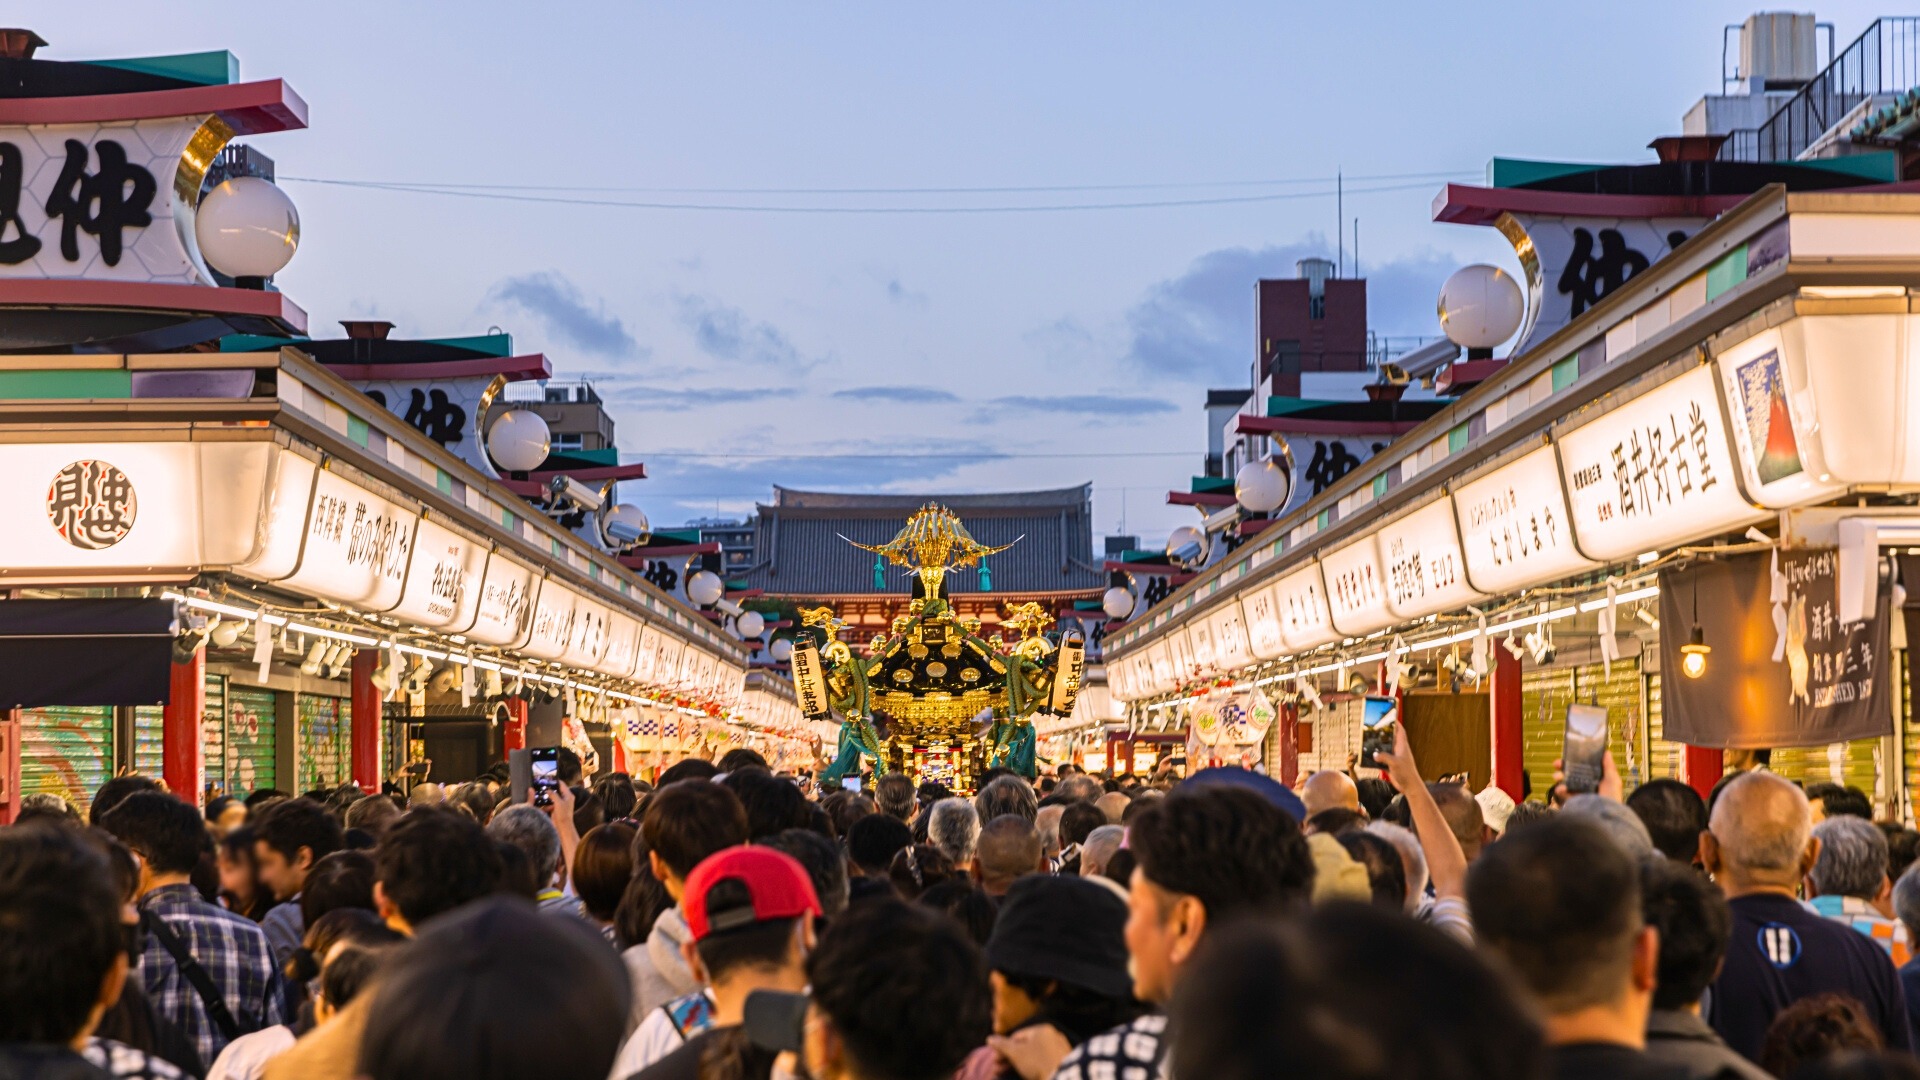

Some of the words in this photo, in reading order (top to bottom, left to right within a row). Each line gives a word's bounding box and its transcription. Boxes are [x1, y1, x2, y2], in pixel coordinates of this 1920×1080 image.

[1610, 400, 1717, 518] 酒井好古堂
[1490, 505, 1556, 566] たかしまや
